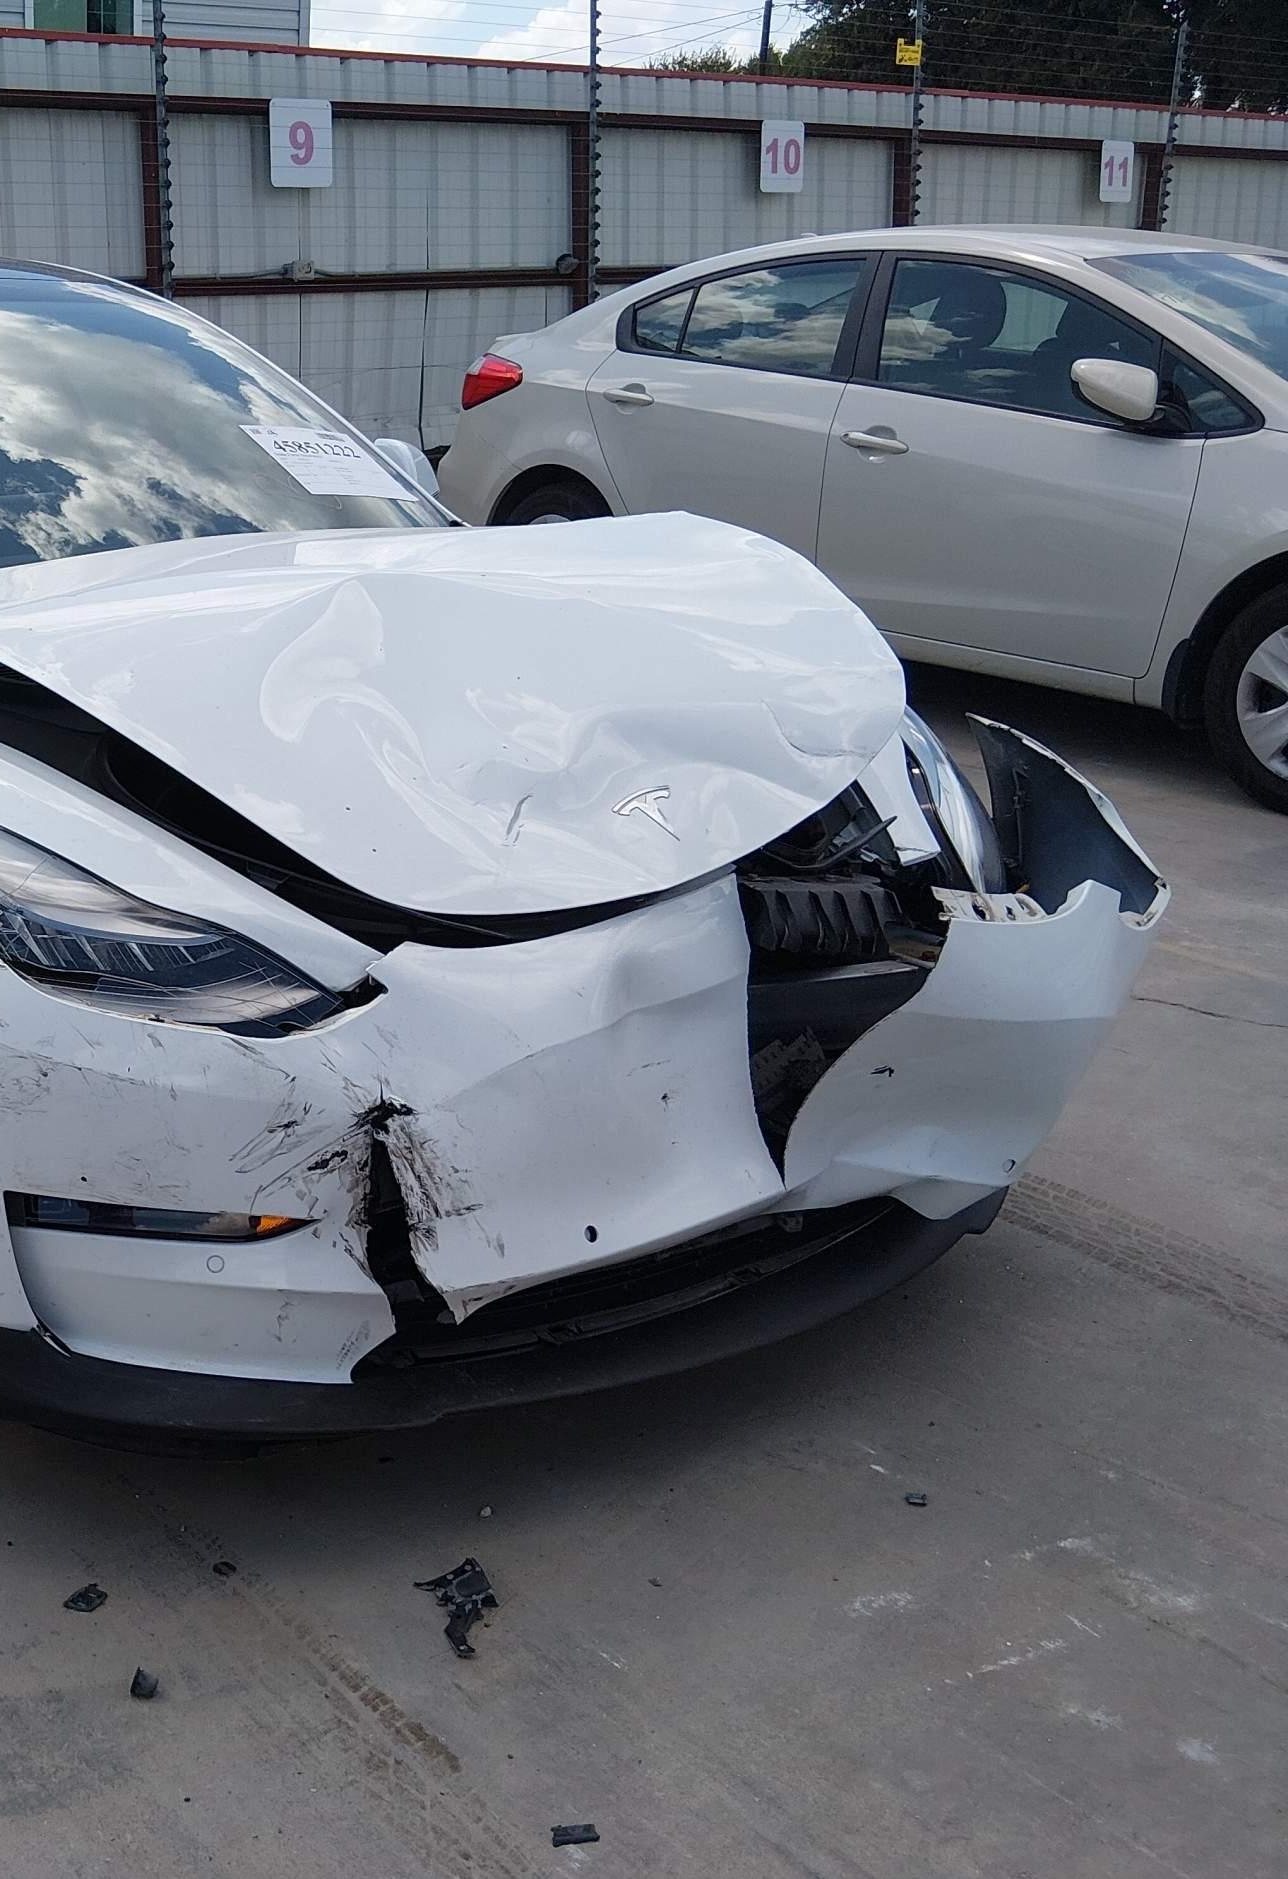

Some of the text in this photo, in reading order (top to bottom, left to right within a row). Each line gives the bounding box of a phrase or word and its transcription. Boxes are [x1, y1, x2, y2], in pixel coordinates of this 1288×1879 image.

[289, 121, 313, 165] 9
[765, 138, 801, 175] 10
[1104, 156, 1128, 187] 11
[273, 440, 361, 458] 45851222
